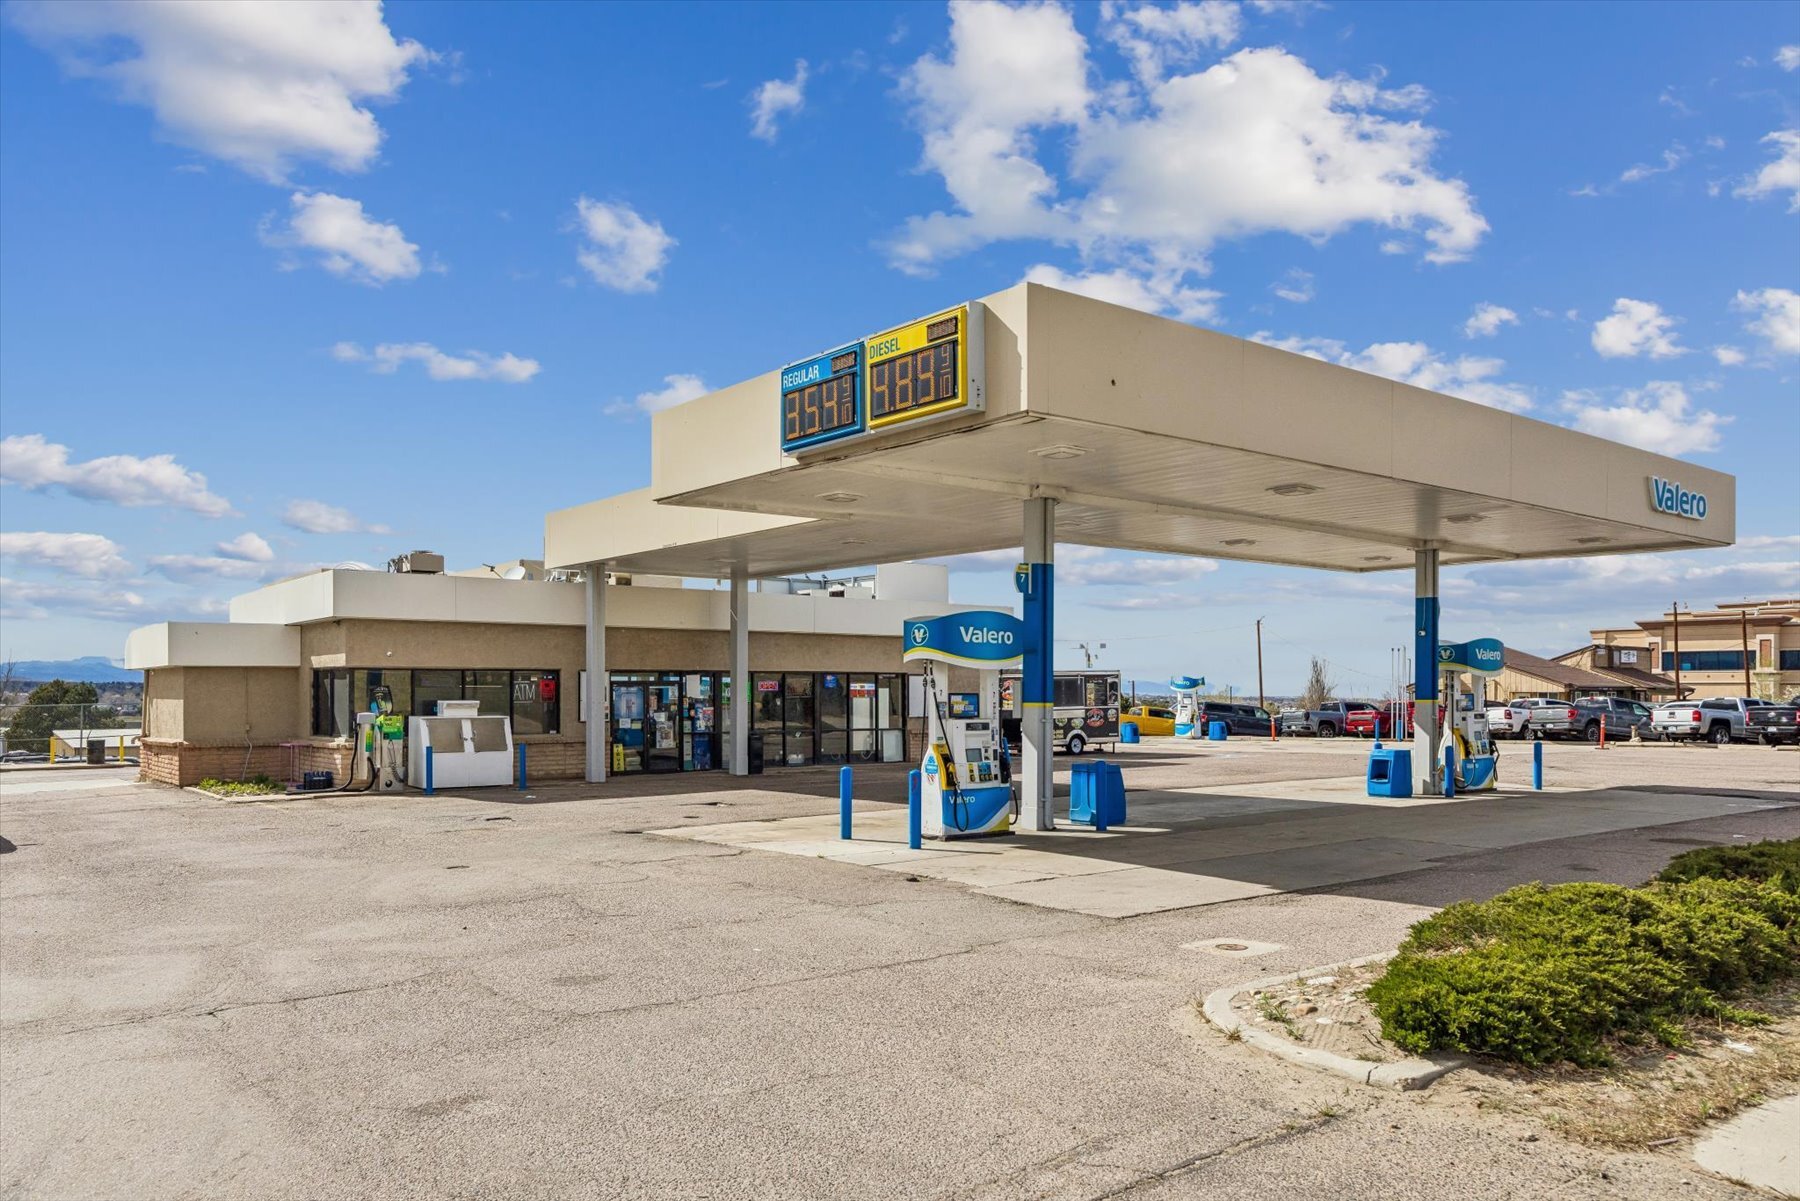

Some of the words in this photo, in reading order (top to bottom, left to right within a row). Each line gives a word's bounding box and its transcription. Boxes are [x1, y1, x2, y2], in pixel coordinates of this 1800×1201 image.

[869, 337, 901, 359] DIESEL
[783, 364, 819, 389] REGULAR
[1652, 477, 1707, 519] Valero
[1020, 574, 1026, 583] 7
[960, 626, 1014, 645] Valero
[1475, 648, 1501, 661] Valero
[513, 684, 536, 701] ATM
